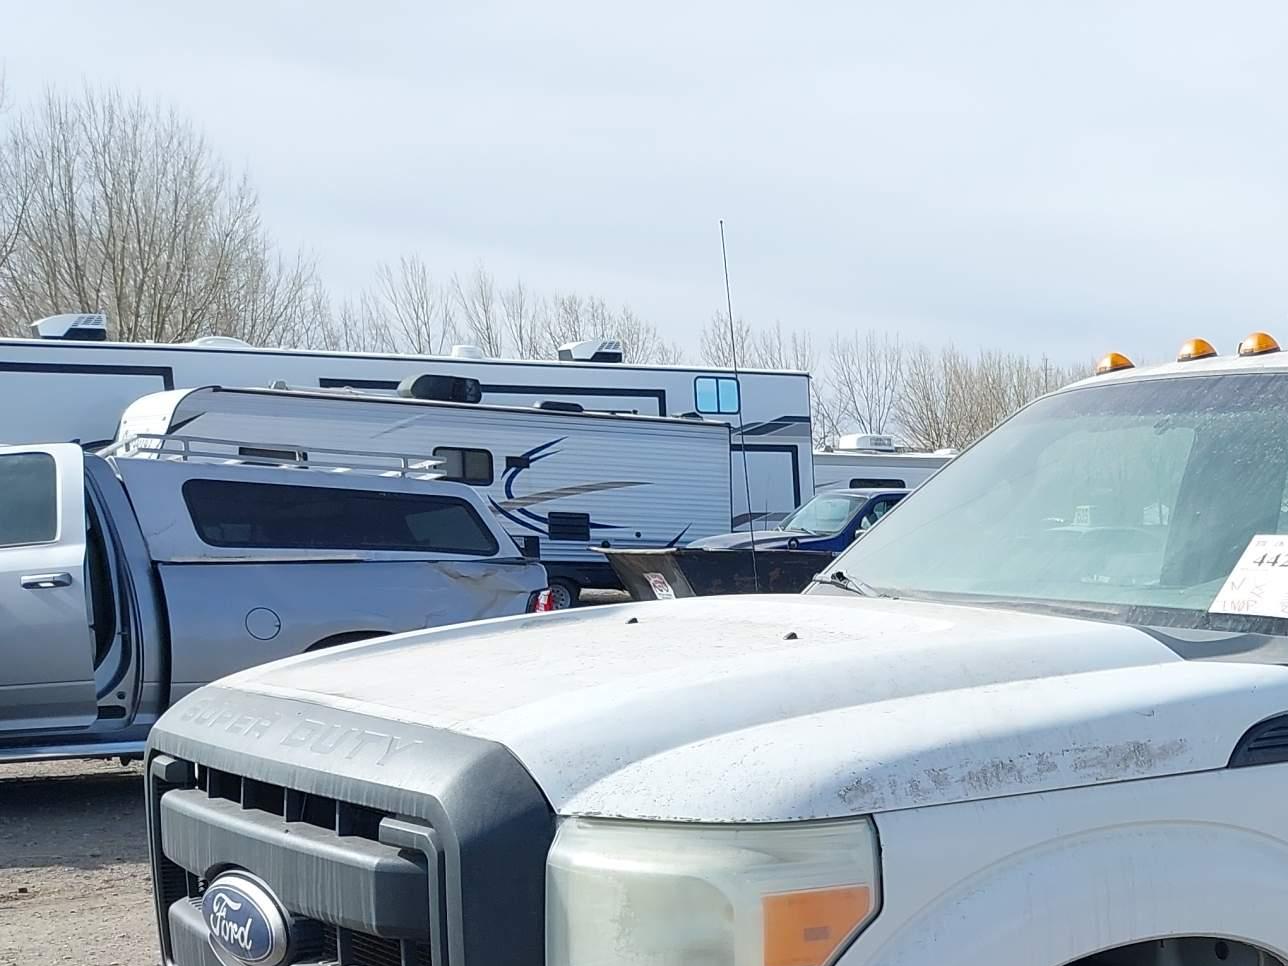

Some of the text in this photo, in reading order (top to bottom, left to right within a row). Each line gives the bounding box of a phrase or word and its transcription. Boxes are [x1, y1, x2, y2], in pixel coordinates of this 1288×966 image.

[180, 698, 424, 767] SUPER DUTY
[210, 892, 253, 951] Ford
